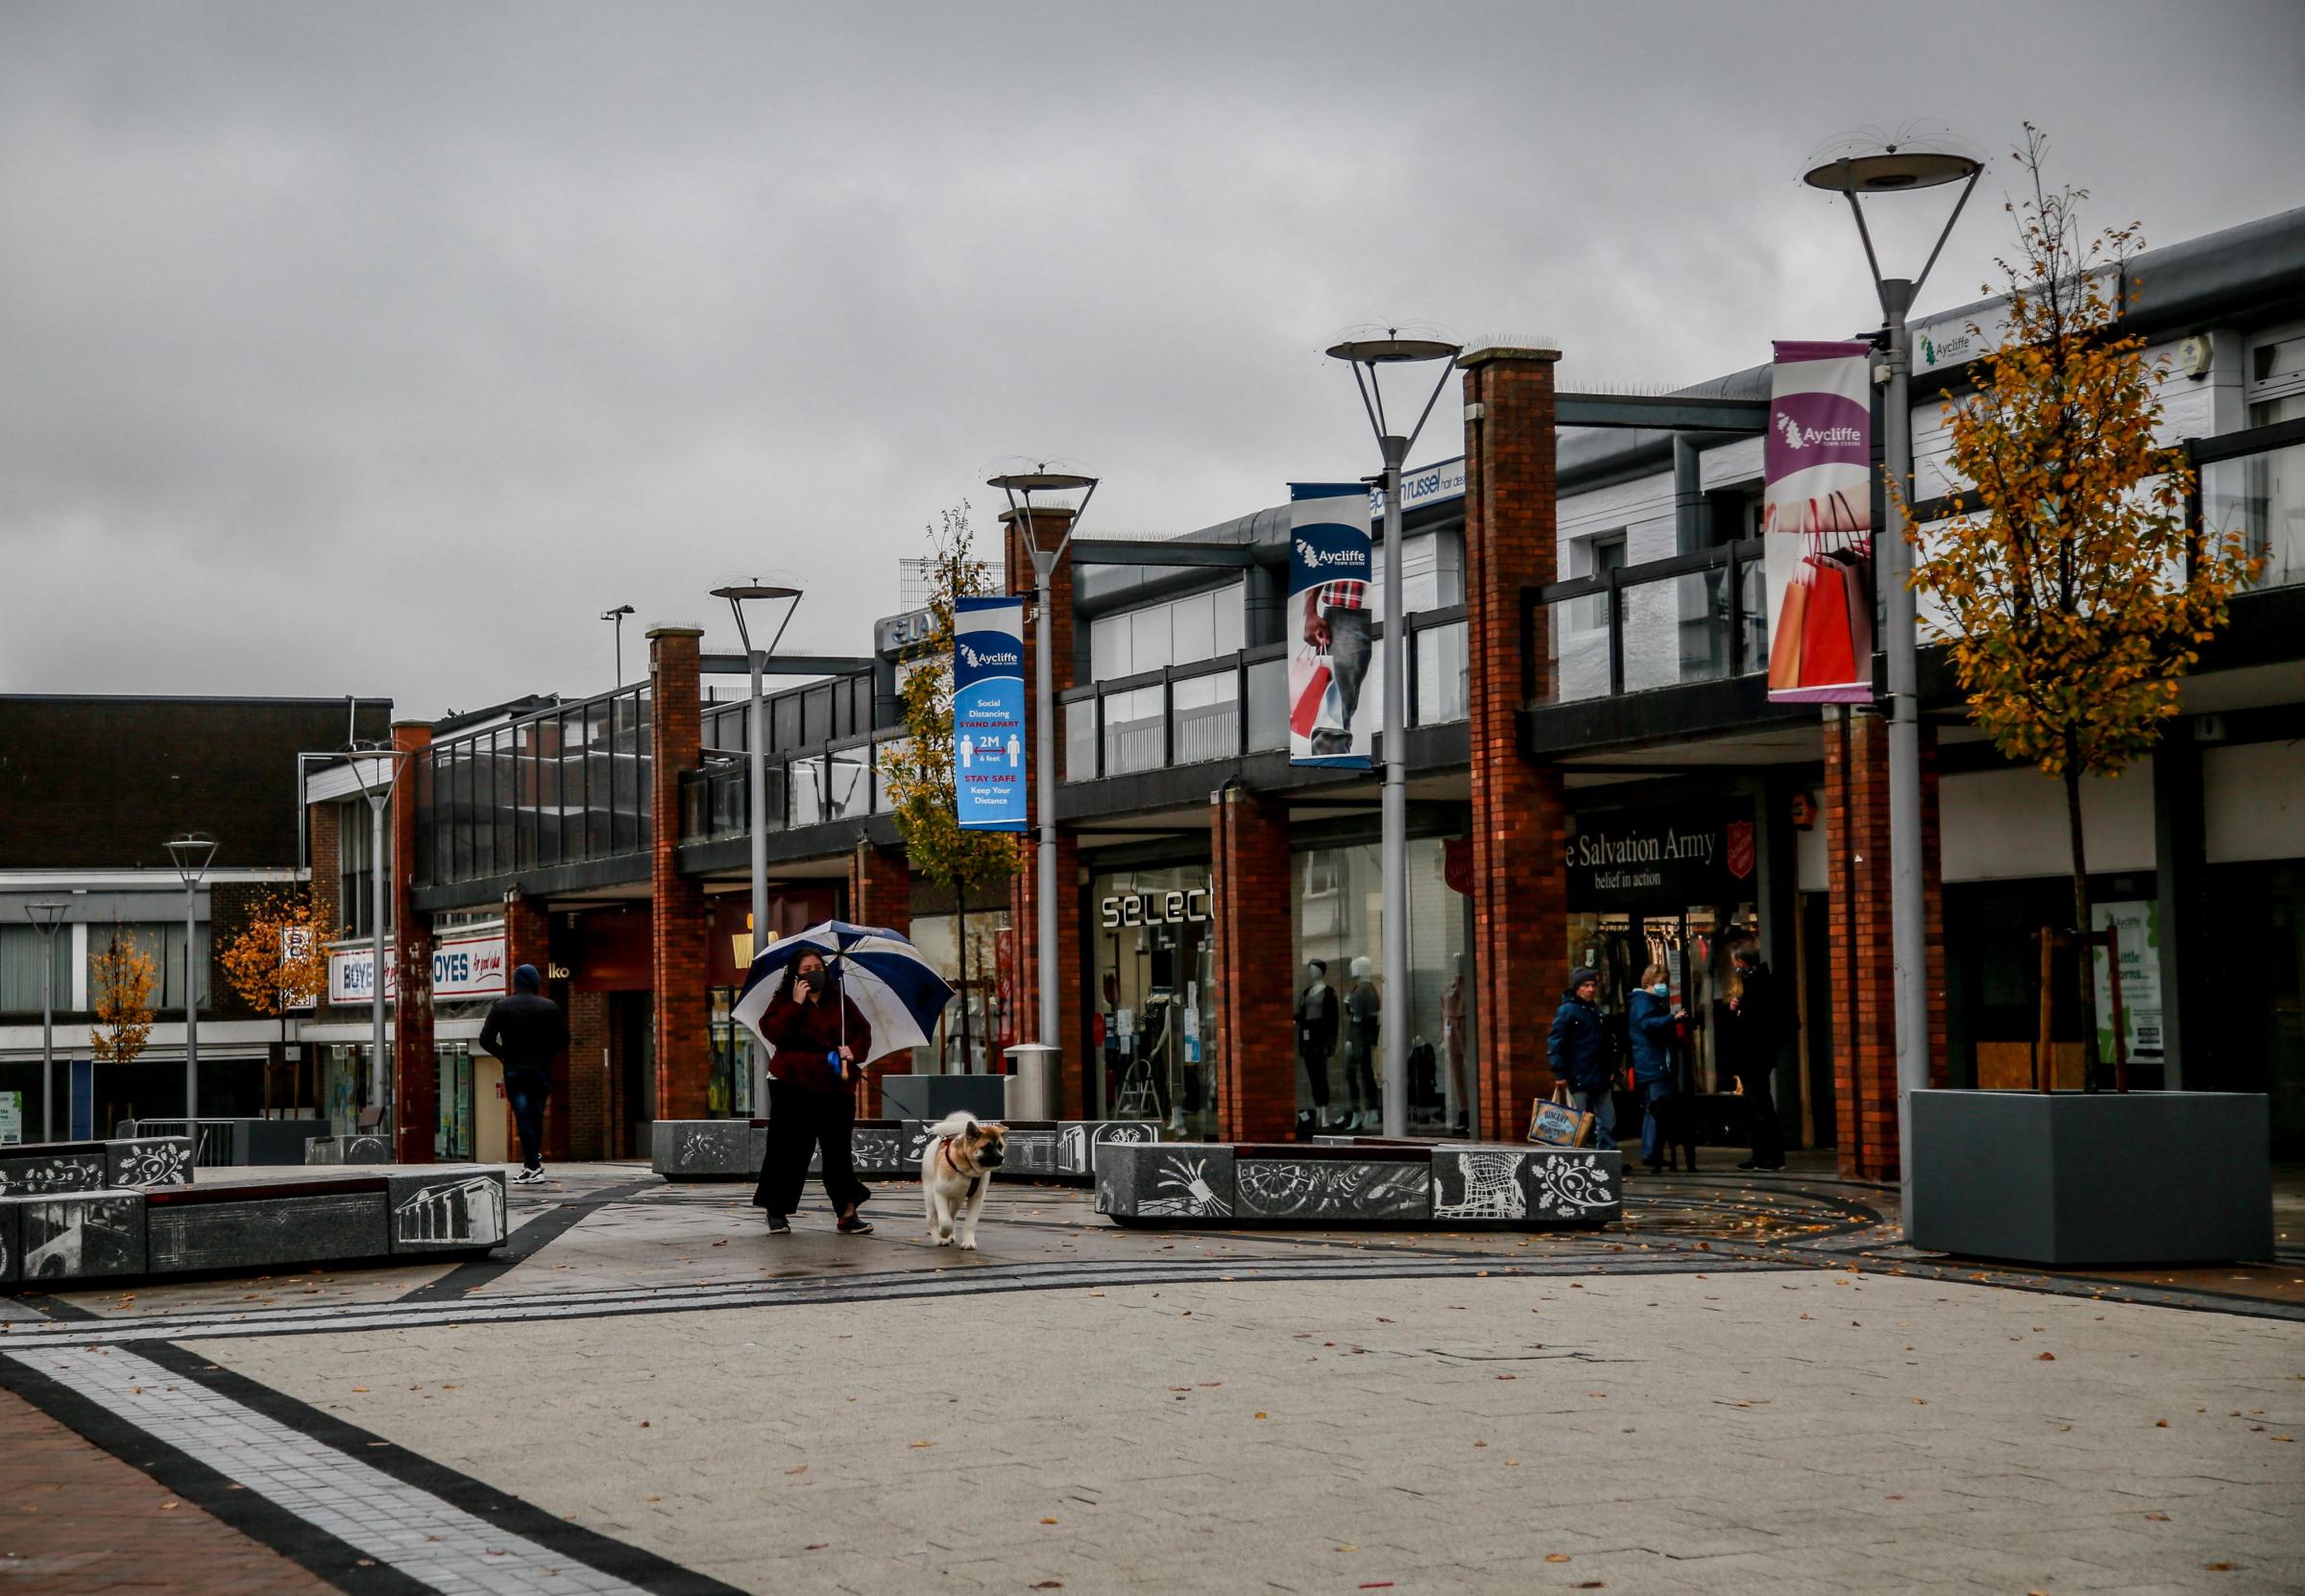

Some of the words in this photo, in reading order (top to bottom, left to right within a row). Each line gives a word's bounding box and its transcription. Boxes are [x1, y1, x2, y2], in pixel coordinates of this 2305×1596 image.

[1936, 336, 1970, 357] Aycliffe
[1804, 427, 1860, 444] Aycliffe
[1442, 478, 1452, 491] hair
[1319, 550, 1365, 565] Aycliffe
[979, 653, 1017, 665] Aycliffe
[969, 711, 1010, 719] Distancing
[980, 737, 999, 747] 2M
[971, 786, 991, 795] Keep
[993, 786, 1011, 795] Your
[1579, 830, 1660, 866] Salvation
[1663, 828, 1715, 865] Army
[1594, 870, 1620, 889] belief
[1622, 872, 1632, 887] in
[1633, 868, 1662, 886] action
[2120, 950, 2141, 963] ittle
[344, 962, 373, 989] BOYE
[433, 953, 468, 982] OYES
[548, 962, 570, 979] lko
